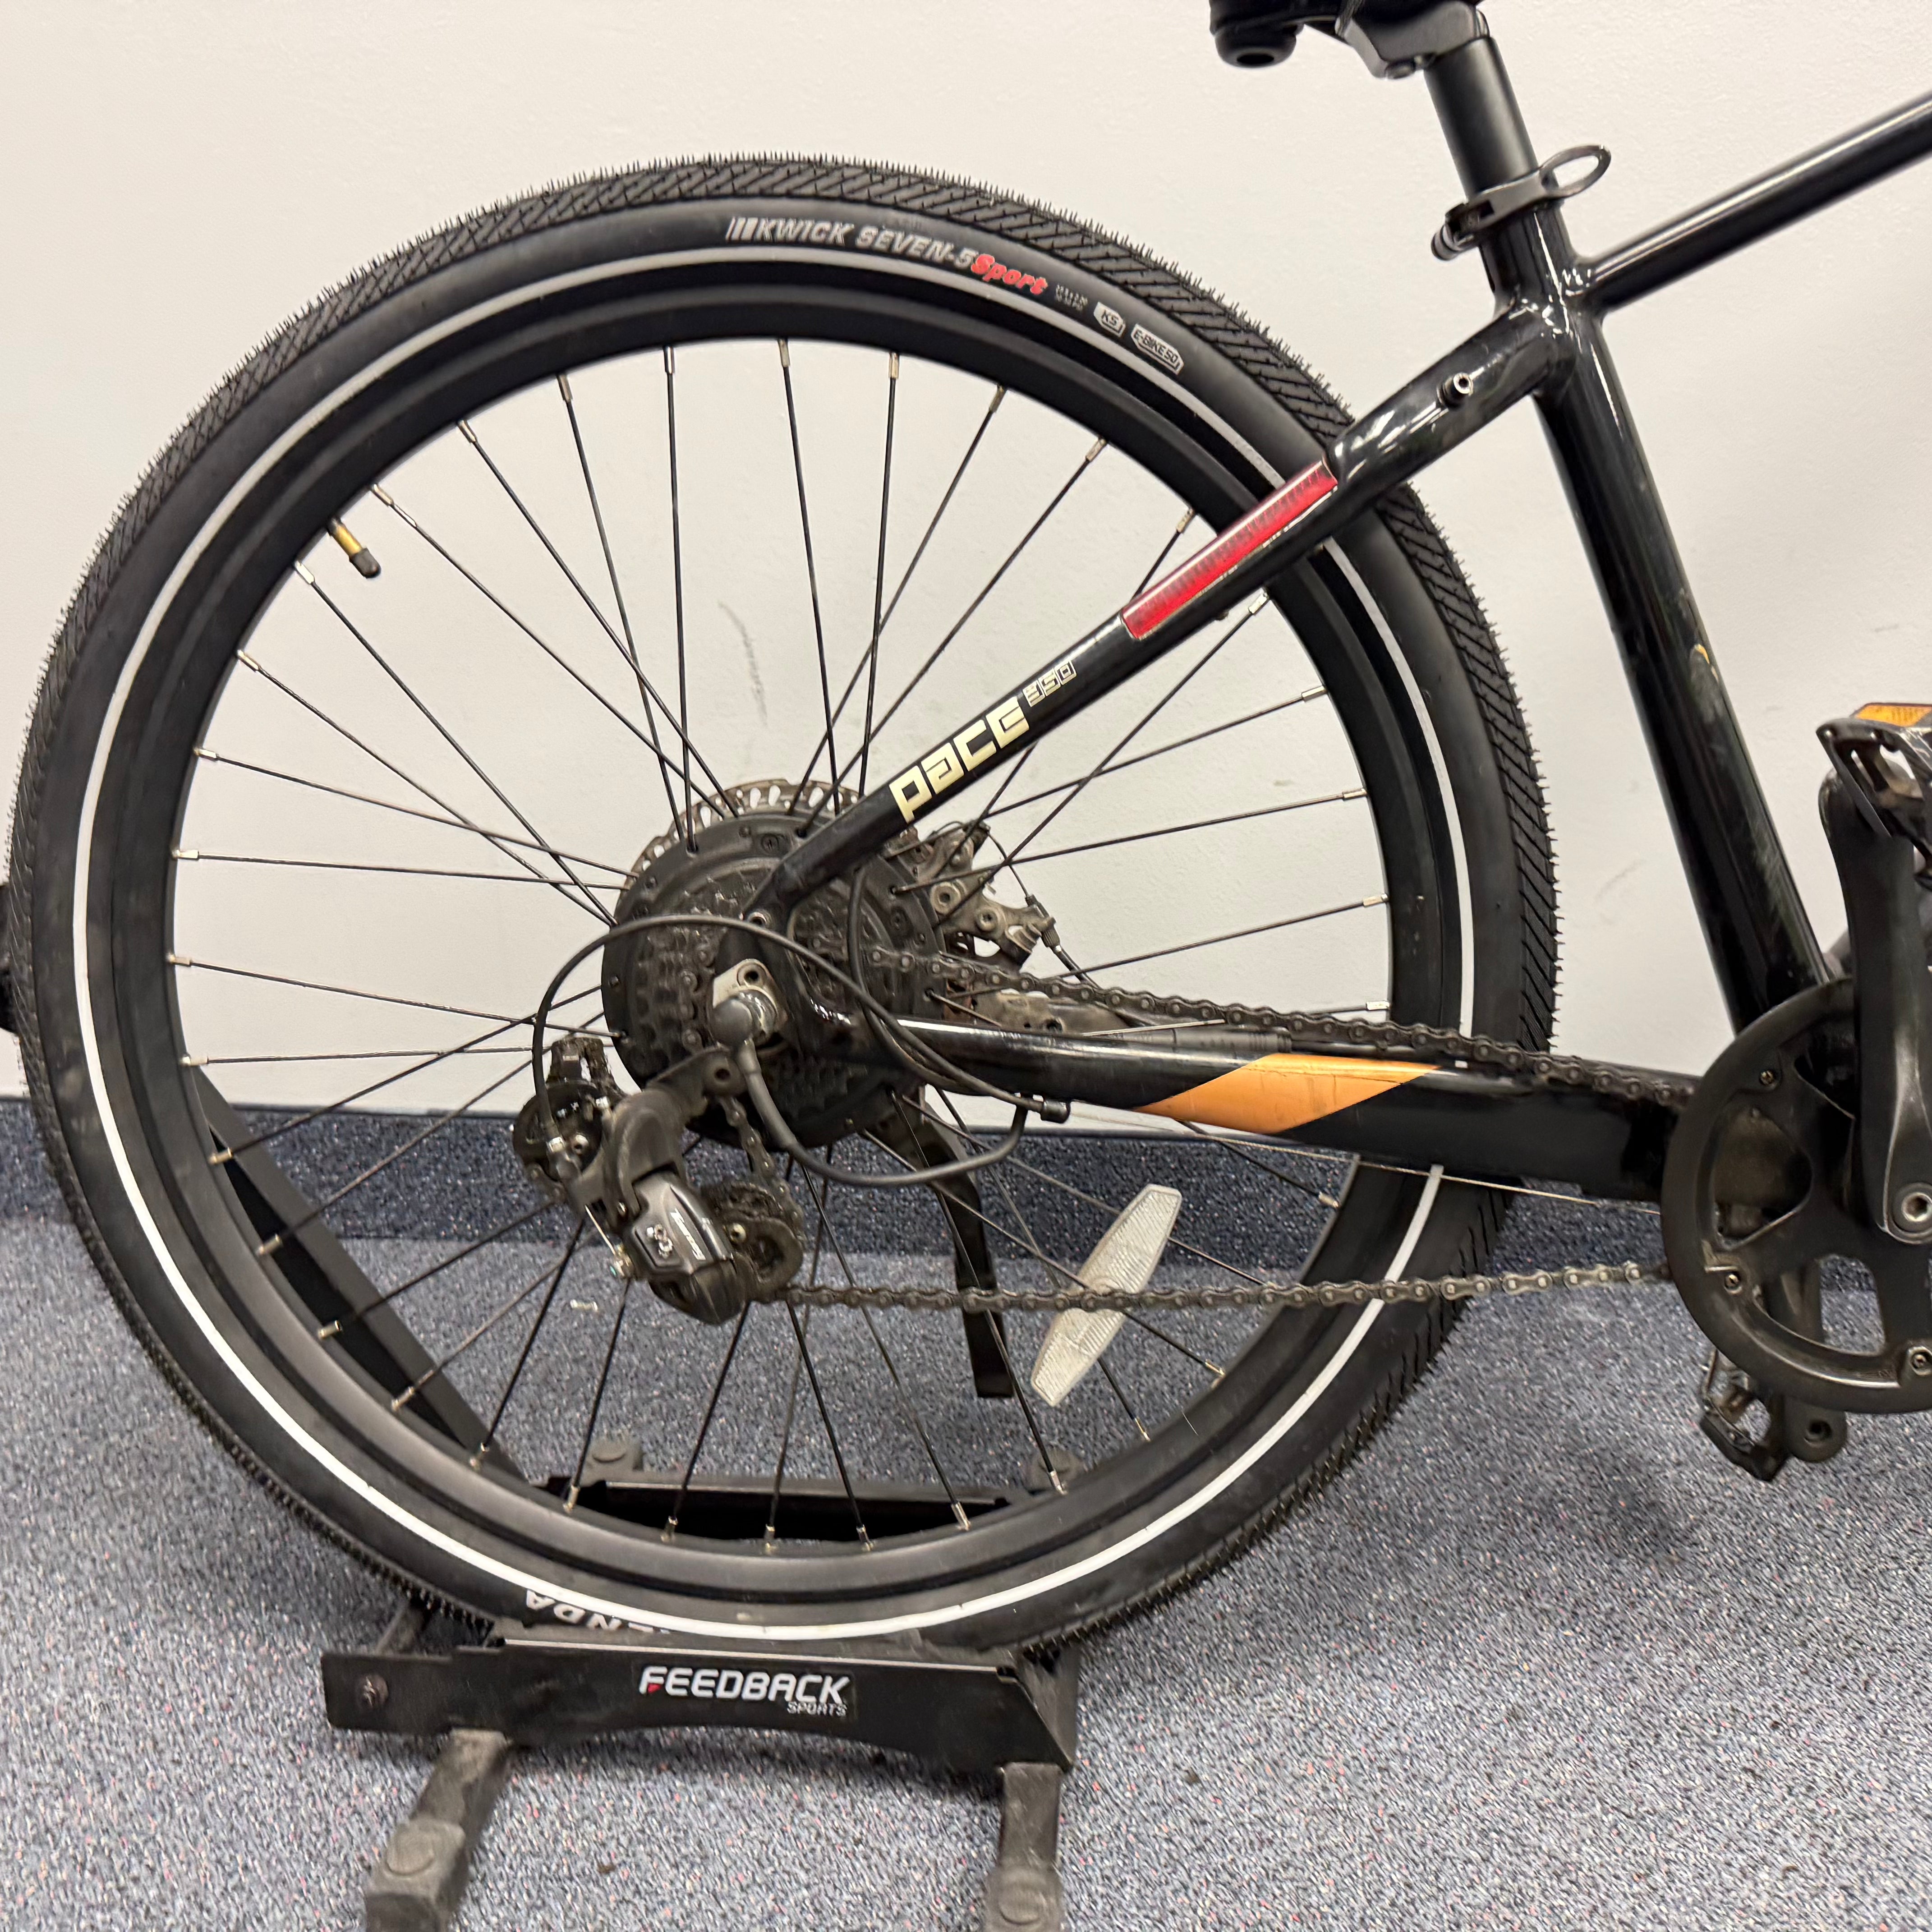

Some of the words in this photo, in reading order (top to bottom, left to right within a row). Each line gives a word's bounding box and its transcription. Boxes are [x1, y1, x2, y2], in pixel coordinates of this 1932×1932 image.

[754, 217, 855, 246] KWICK
[856, 225, 980, 269] SEVEN-5
[971, 253, 1048, 295] Sport
[889, 696, 1030, 824] pace
[1022, 660, 1077, 708] 350
[639, 1666, 851, 1704] FEEDBACK
[787, 1701, 848, 1717] SPORTS
